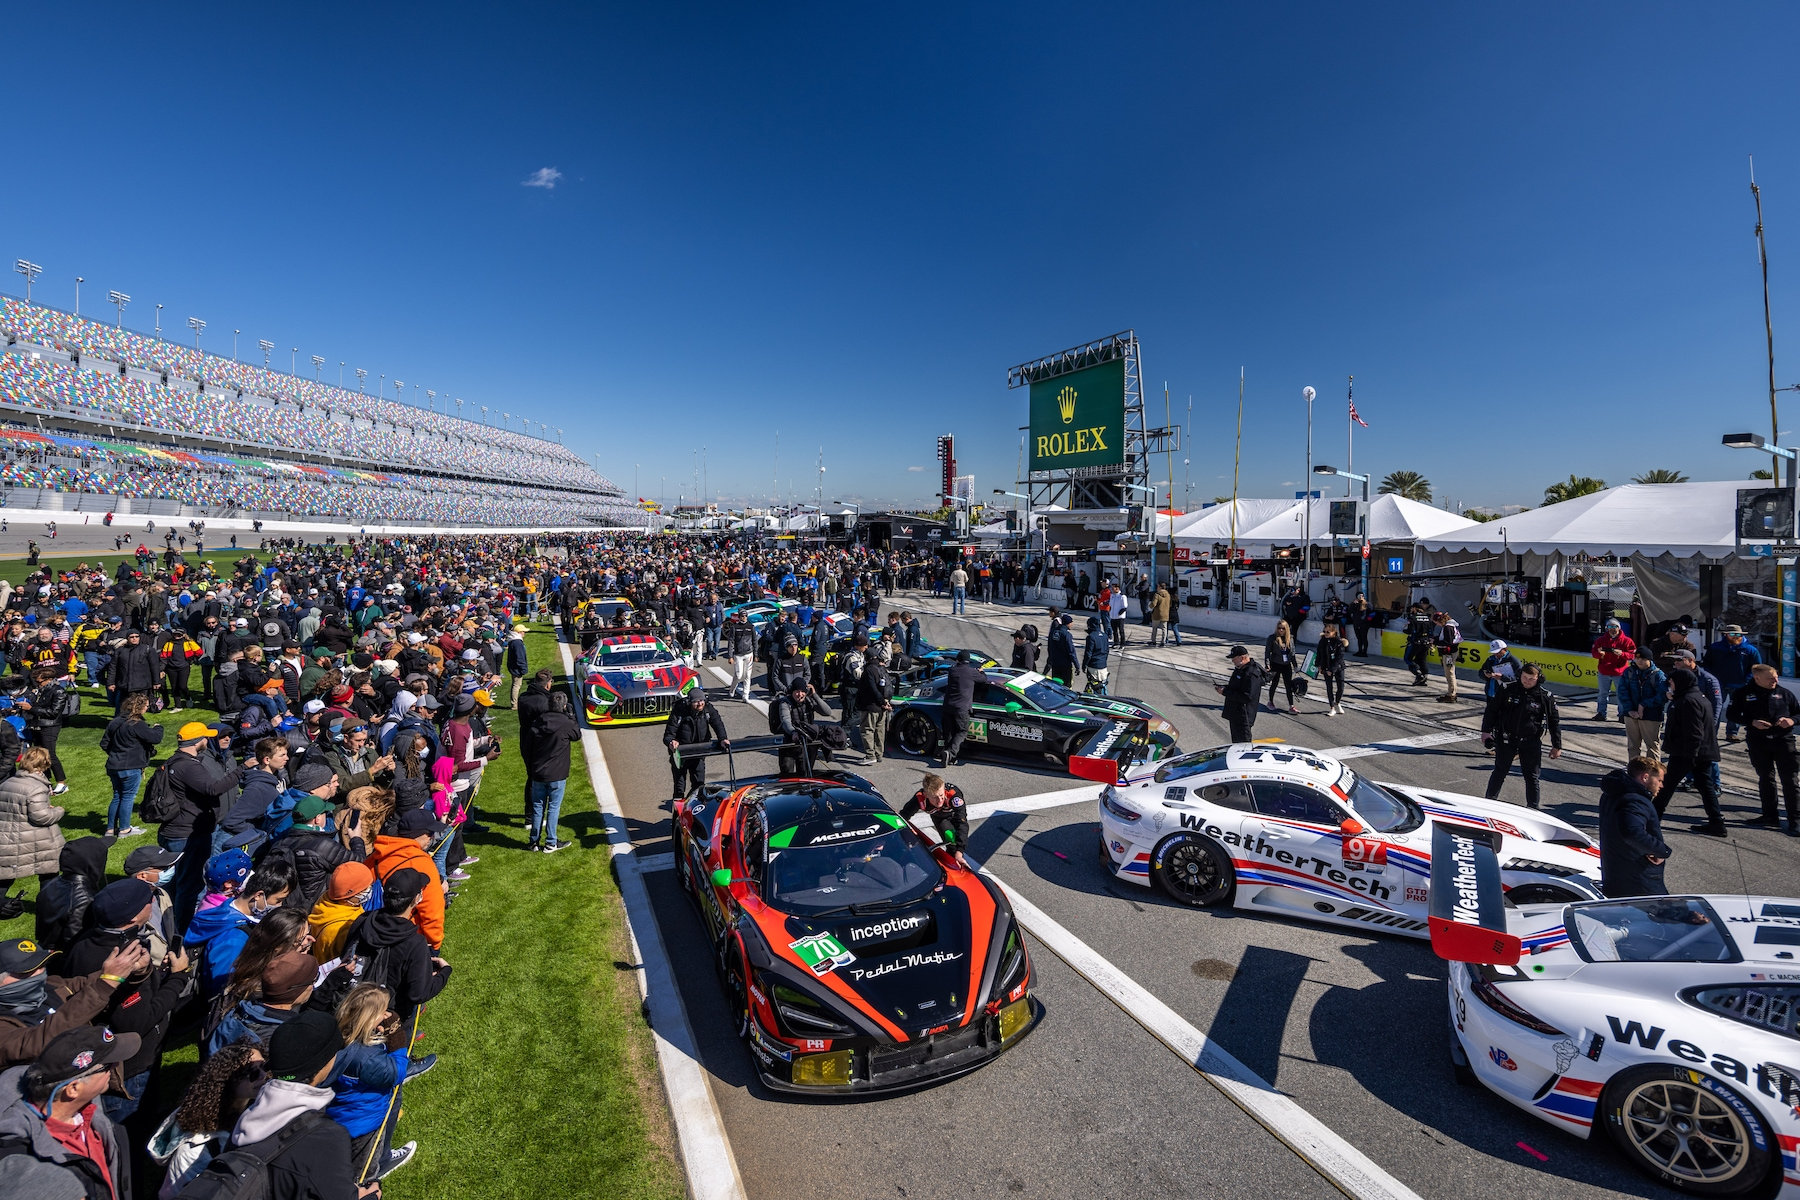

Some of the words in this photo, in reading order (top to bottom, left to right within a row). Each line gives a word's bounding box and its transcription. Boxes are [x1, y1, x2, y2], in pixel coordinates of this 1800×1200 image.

[1037, 426, 1108, 458] ROLEX
[1176, 549, 1187, 558] 24
[1390, 560, 1402, 571] 11
[1083, 595, 1096, 609] 02
[968, 722, 984, 736] 44
[989, 721, 1043, 737] MAGNUS
[809, 828, 876, 845] McLaren
[1158, 835, 1184, 860] MICHELIN
[1179, 812, 1391, 901] WeatherTech
[1348, 838, 1382, 863] 97
[1451, 834, 1480, 925] WeatherTech
[1406, 887, 1427, 895] GTD
[1406, 894, 1427, 902] PRO
[851, 917, 919, 940] inception
[803, 938, 841, 960] 70
[749, 984, 767, 1006] MOTUL
[806, 1039, 825, 1049] PR
[1673, 1066, 1690, 1082] RR
[1714, 1085, 1766, 1147] MICHELIN
